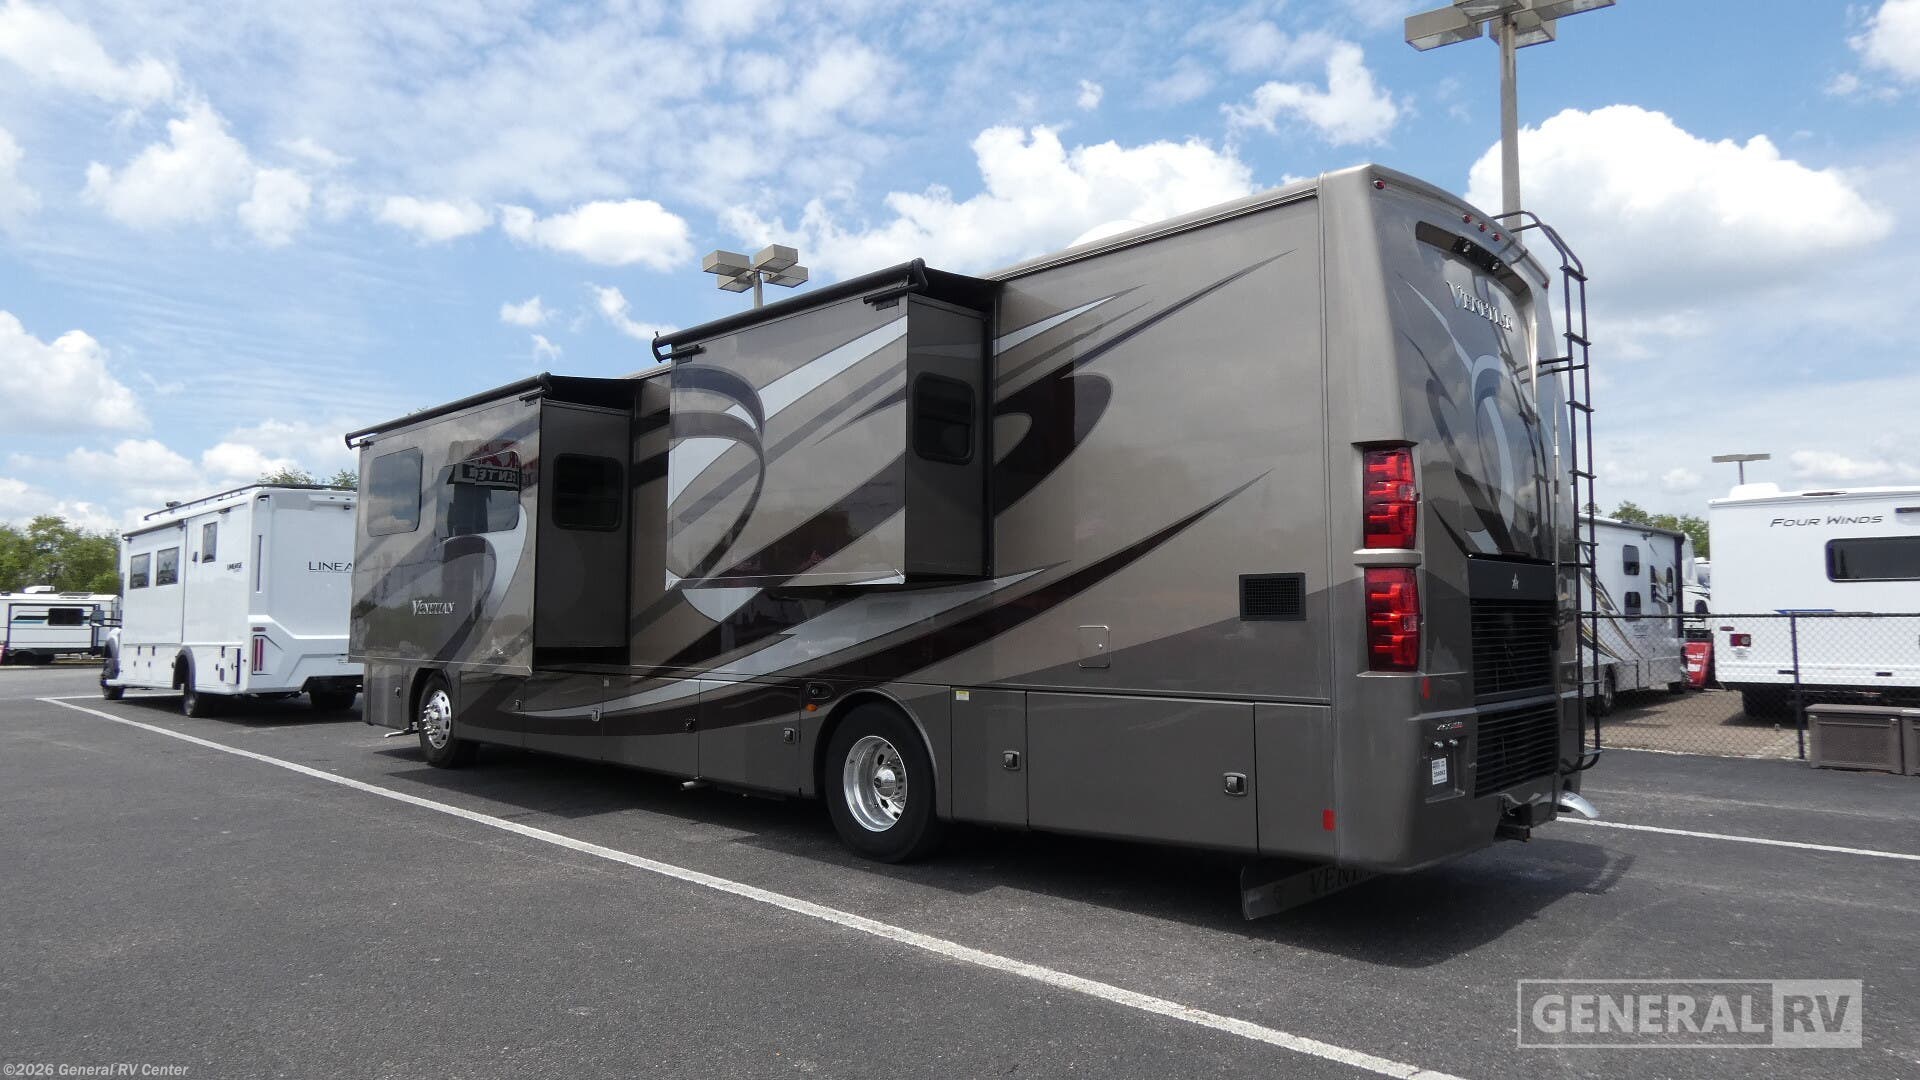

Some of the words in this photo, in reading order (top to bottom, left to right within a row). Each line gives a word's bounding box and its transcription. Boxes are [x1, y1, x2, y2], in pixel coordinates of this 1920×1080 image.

[1769, 518, 1821, 528] FOUR
[1826, 515, 1884, 525] WINDS
[308, 561, 352, 571] LINEA
